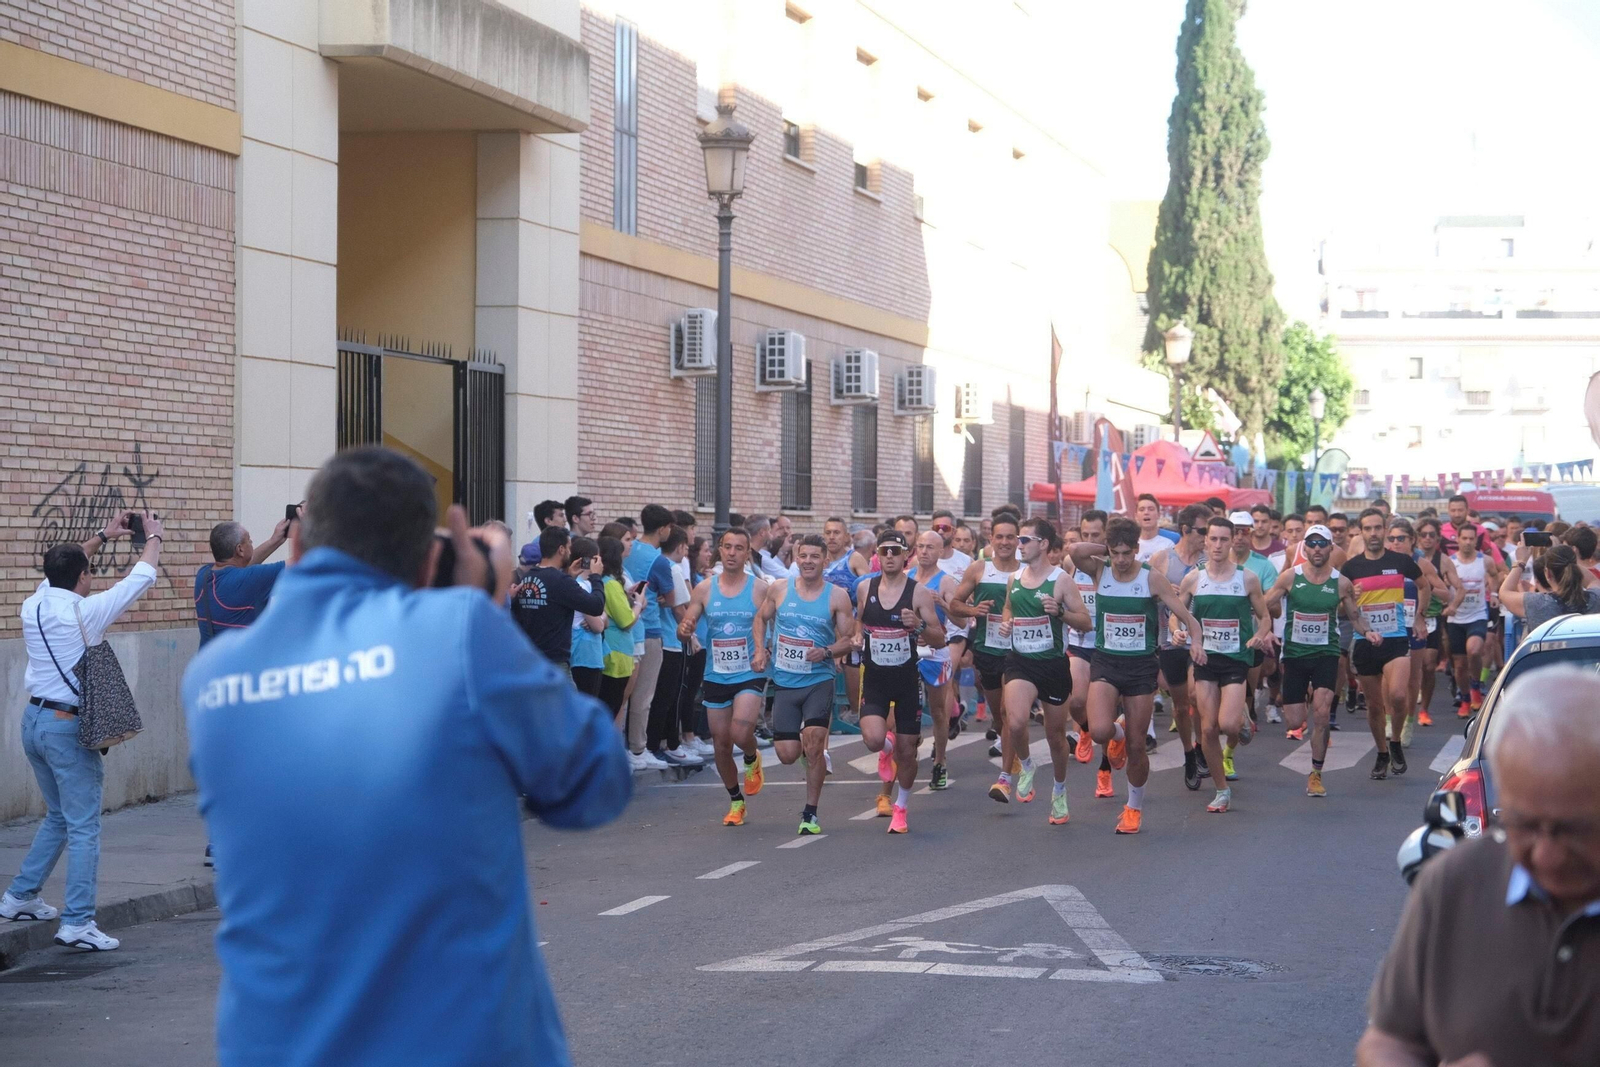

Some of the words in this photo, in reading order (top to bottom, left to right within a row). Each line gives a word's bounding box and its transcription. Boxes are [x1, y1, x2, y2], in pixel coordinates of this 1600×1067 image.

[1370, 612, 1390, 624] 210
[1022, 629, 1043, 640] 274
[1114, 627, 1136, 638] 289
[1301, 624, 1321, 634] 669
[1212, 630, 1231, 641] 278
[880, 642, 901, 653] 224
[720, 650, 740, 661] 283
[784, 647, 804, 660] 284
